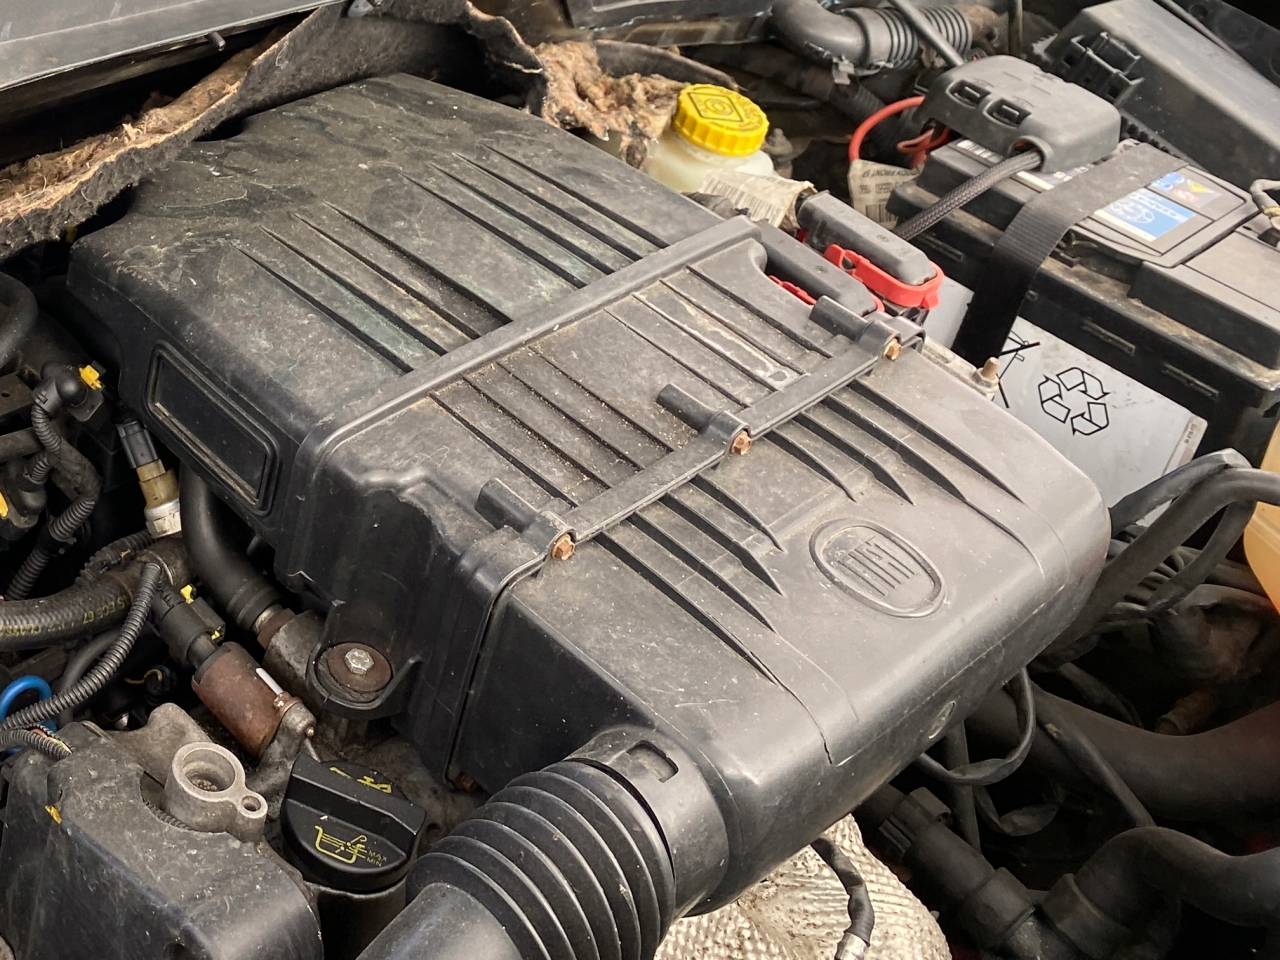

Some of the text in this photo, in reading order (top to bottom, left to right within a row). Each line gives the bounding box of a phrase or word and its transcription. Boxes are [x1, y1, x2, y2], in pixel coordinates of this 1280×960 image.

[82, 609, 95, 625] 67
[368, 850, 387, 861] MAX
[366, 857, 382, 867] MIN
